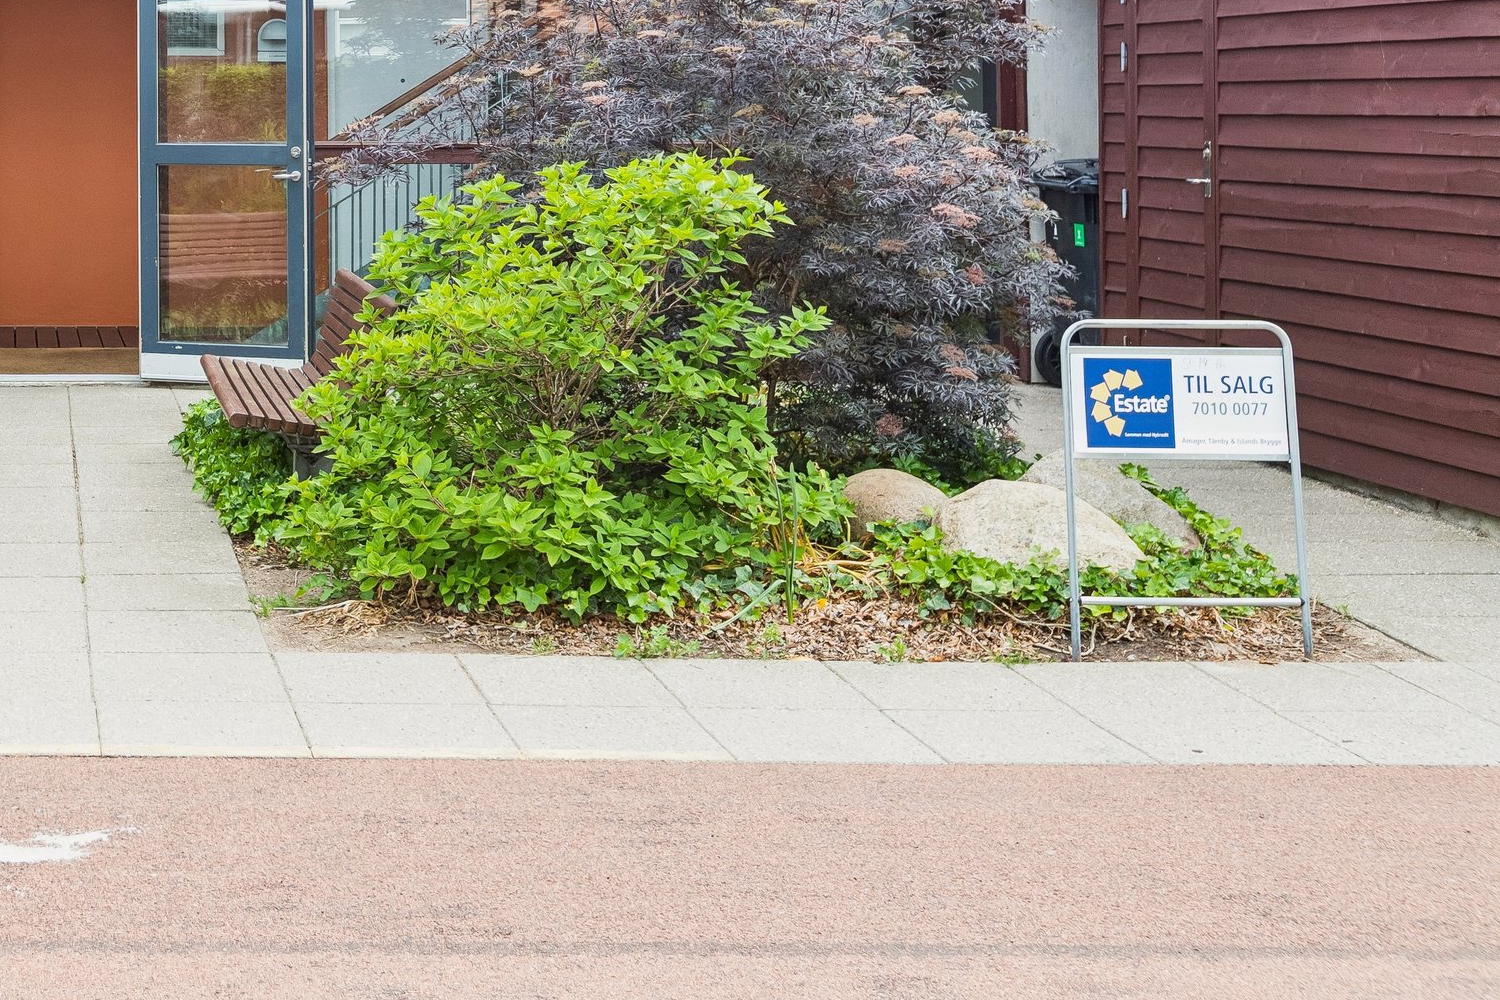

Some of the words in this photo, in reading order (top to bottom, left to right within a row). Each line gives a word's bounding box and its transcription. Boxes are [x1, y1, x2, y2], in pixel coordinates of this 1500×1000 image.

[1183, 375, 1213, 394] TIL
[1220, 375, 1274, 395] SALG
[1114, 393, 1169, 413] Estate
[1192, 401, 1228, 416] 7010
[1232, 402, 1268, 416] 0077
